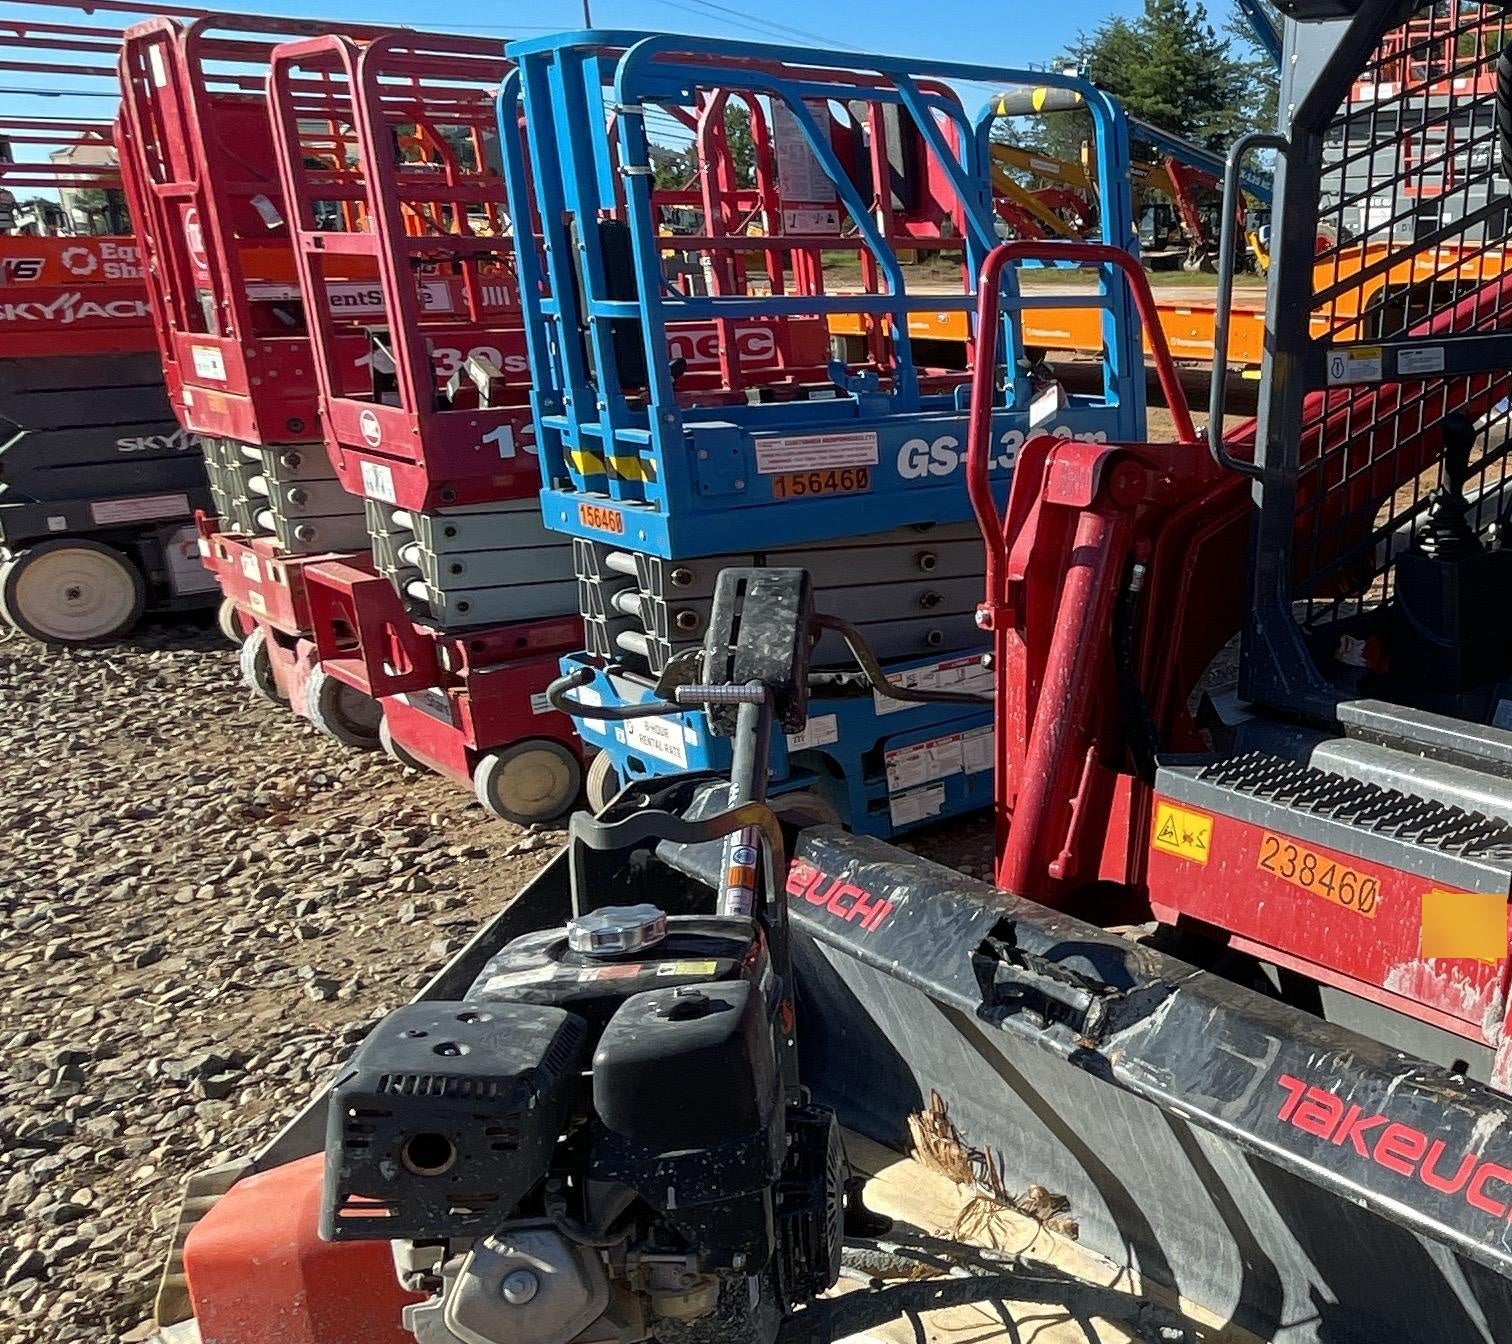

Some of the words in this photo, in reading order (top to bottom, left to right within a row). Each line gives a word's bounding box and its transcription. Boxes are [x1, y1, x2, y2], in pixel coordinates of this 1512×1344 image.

[775, 466, 869, 498] 156460
[580, 506, 622, 533] 156460
[1261, 835, 1380, 915] 238460
